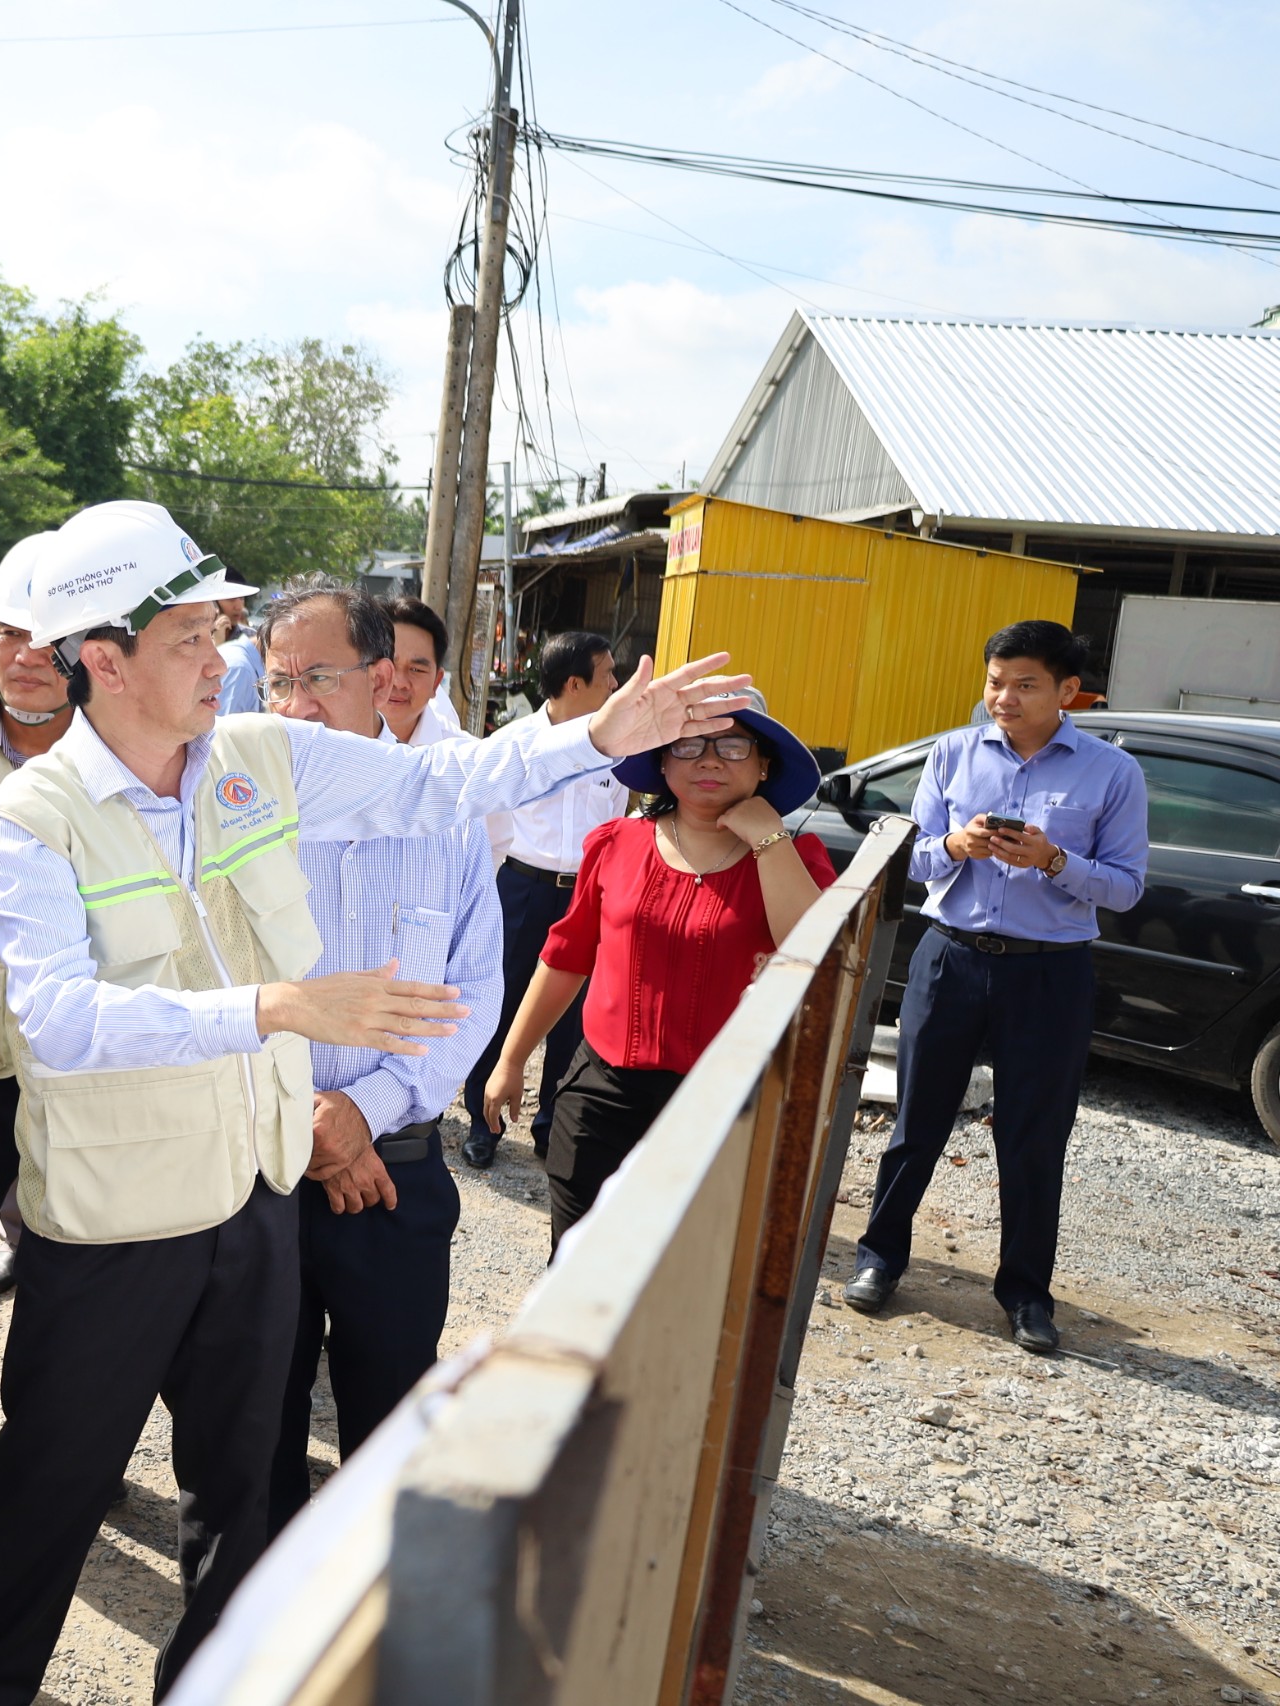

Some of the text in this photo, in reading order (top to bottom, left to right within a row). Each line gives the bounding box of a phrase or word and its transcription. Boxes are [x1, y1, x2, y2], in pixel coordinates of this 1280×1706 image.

[57, 580, 74, 593] GIAO
[75, 570, 103, 586] THÔNG
[96, 576, 114, 588] THƠ
[229, 816, 243, 826] GIAO
[243, 807, 261, 819] THÔNG
